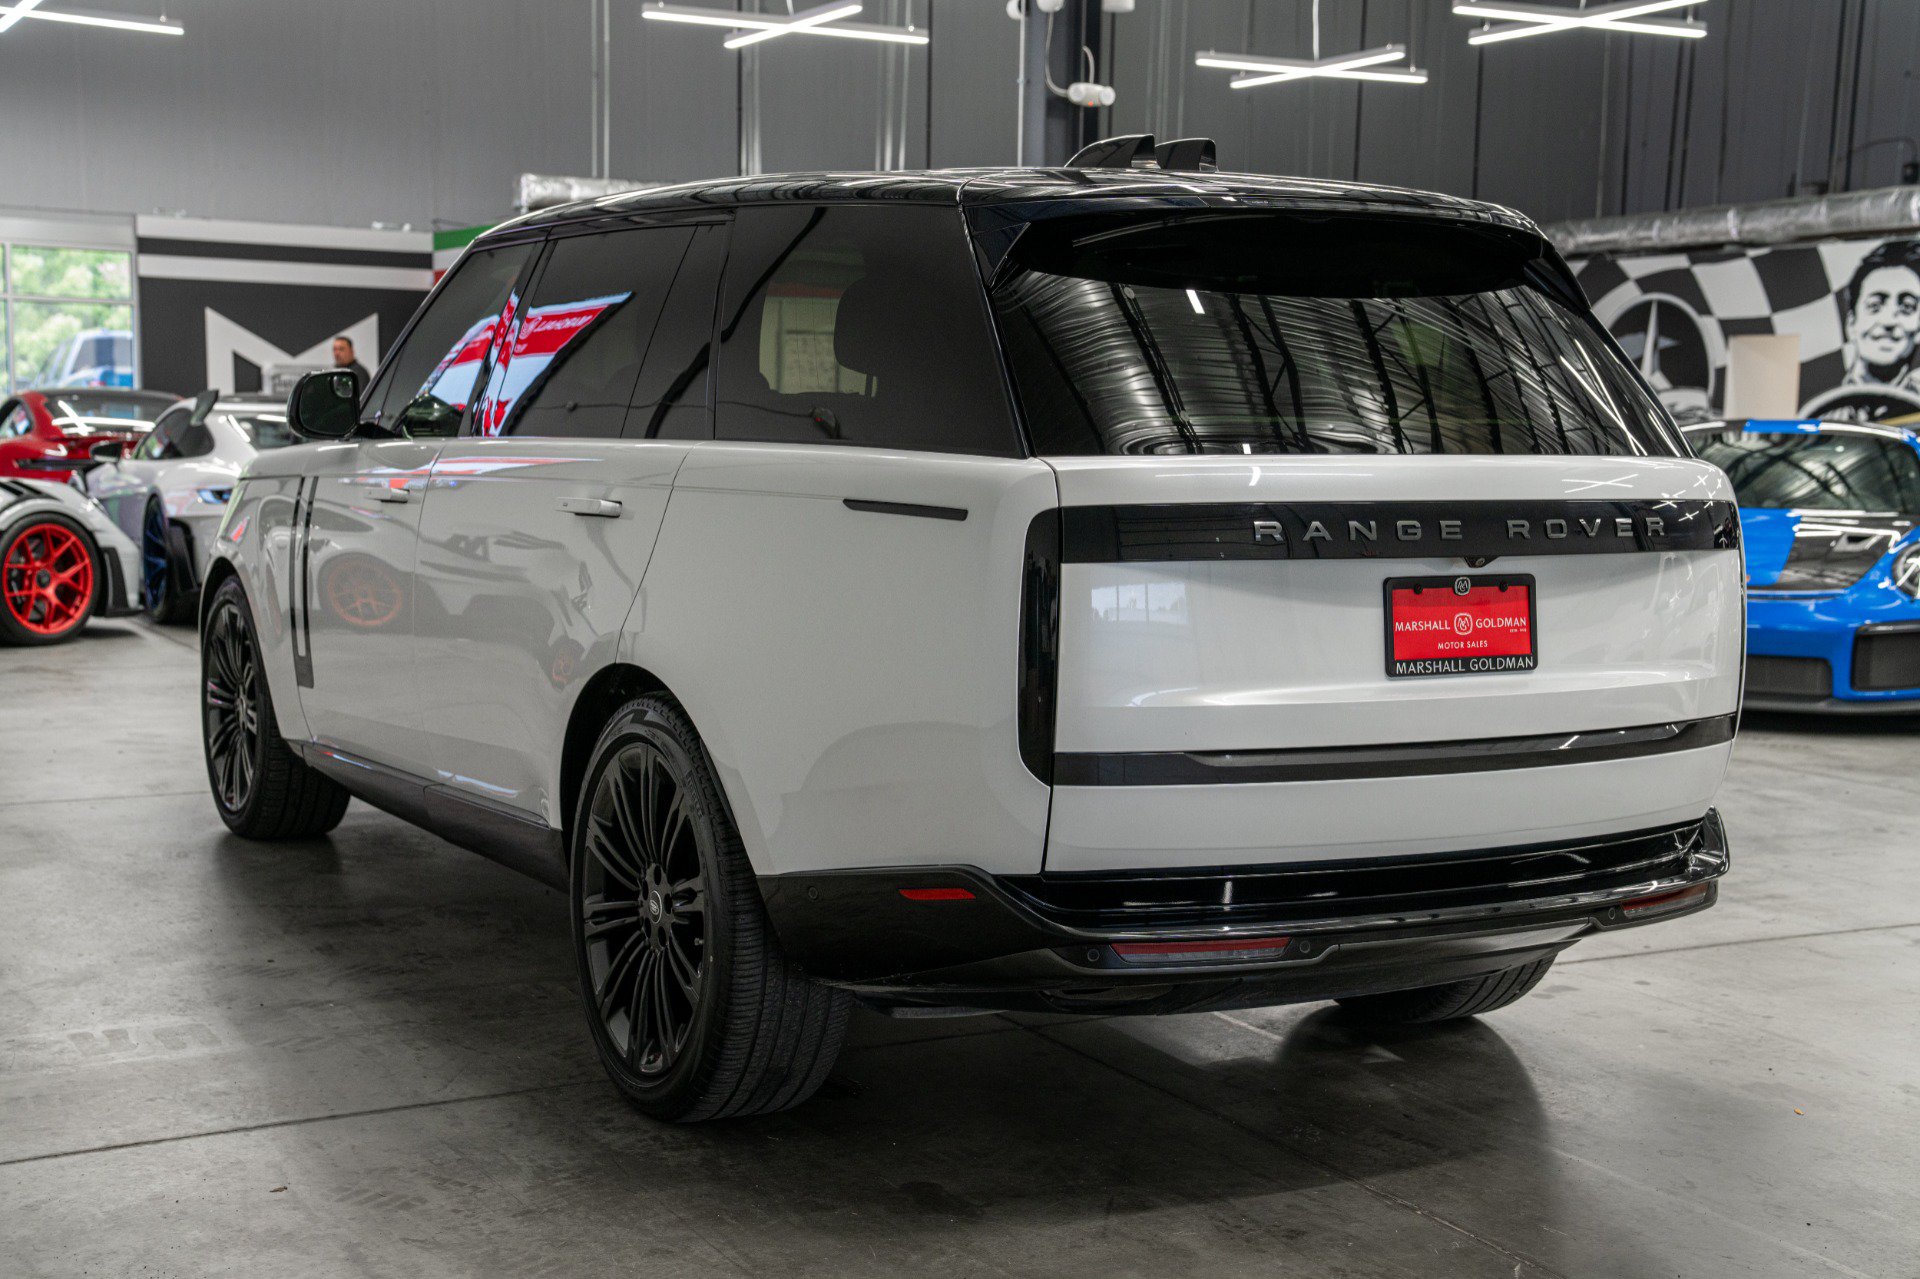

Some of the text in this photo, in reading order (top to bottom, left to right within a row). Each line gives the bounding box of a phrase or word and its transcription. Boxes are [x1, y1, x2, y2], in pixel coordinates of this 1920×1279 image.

[1253, 516, 1666, 542] RANGE ROVER
[1395, 620, 1451, 632] MARSHALL
[1475, 617, 1527, 629] GOLDMAN
[1437, 640, 1488, 650] MOTOR SALES
[1396, 656, 1534, 675] MARSHALL GOLDMAN
